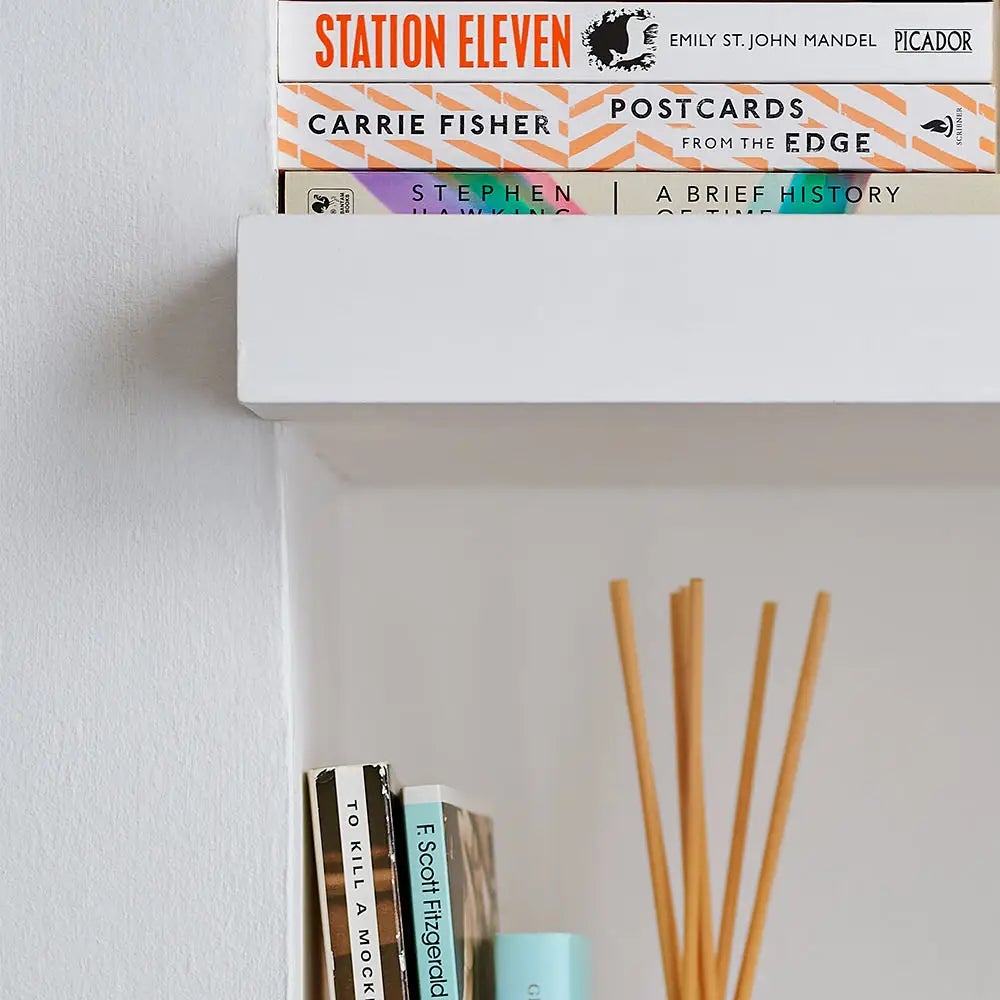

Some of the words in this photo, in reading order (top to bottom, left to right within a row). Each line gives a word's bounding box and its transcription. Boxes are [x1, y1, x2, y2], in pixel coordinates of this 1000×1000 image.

[315, 13, 445, 68] STATION
[459, 14, 571, 68] ELEVEN
[670, 33, 716, 47] EMILY
[722, 33, 745, 47] ST.
[749, 33, 797, 51] JOHN
[804, 33, 877, 47] MANDEL
[895, 29, 973, 52] PICADOR
[611, 98, 804, 119] POSTCARDS
[308, 114, 425, 135] CARRIE
[440, 114, 551, 135] FISHER
[682, 137, 733, 150] FROM
[741, 137, 775, 150] THE
[785, 132, 870, 153] EDGE
[412, 184, 570, 202] STEPHEN
[656, 185, 672, 202] A
[687, 185, 765, 203] BRIEF
[780, 185, 900, 203] HISTORY
[347, 799, 360, 827] TO
[416, 824, 435, 836] F.
[350, 841, 365, 889] KILL
[418, 841, 440, 894] Scott
[356, 902, 367, 916] A
[421, 899, 449, 998] Fitzgerald
